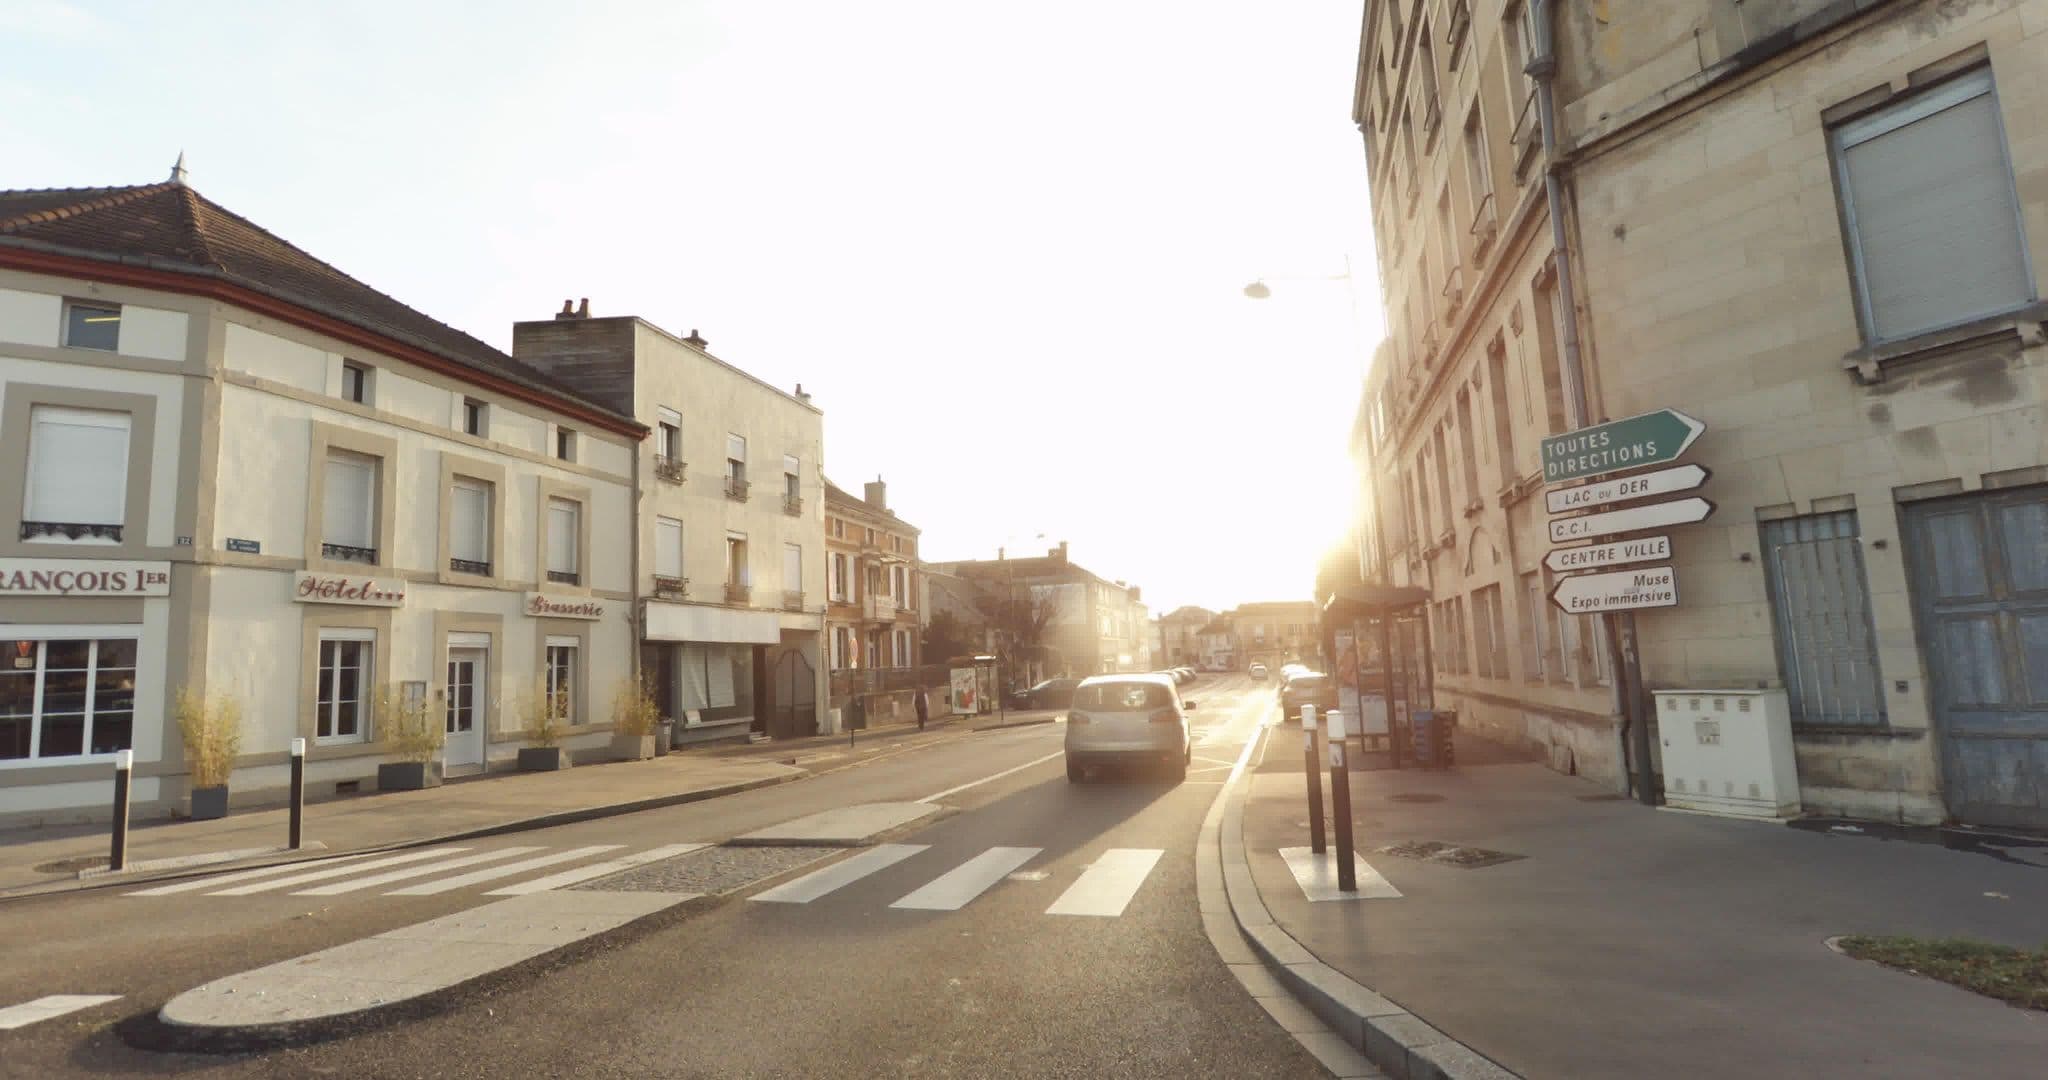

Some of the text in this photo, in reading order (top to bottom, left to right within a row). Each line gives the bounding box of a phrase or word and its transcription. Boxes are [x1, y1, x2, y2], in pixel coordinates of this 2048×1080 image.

[1547, 431, 1610, 459] TOUTES
[1548, 441, 1657, 477] DIRECTIONS
[1565, 490, 1591, 505] LAC
[1619, 479, 1649, 495] DER
[1560, 541, 1665, 566] CENTRE VILLE
[299, 576, 375, 600] Hôtel
[1571, 591, 1671, 609] Expo immersive
[531, 595, 606, 616] Brasserie
